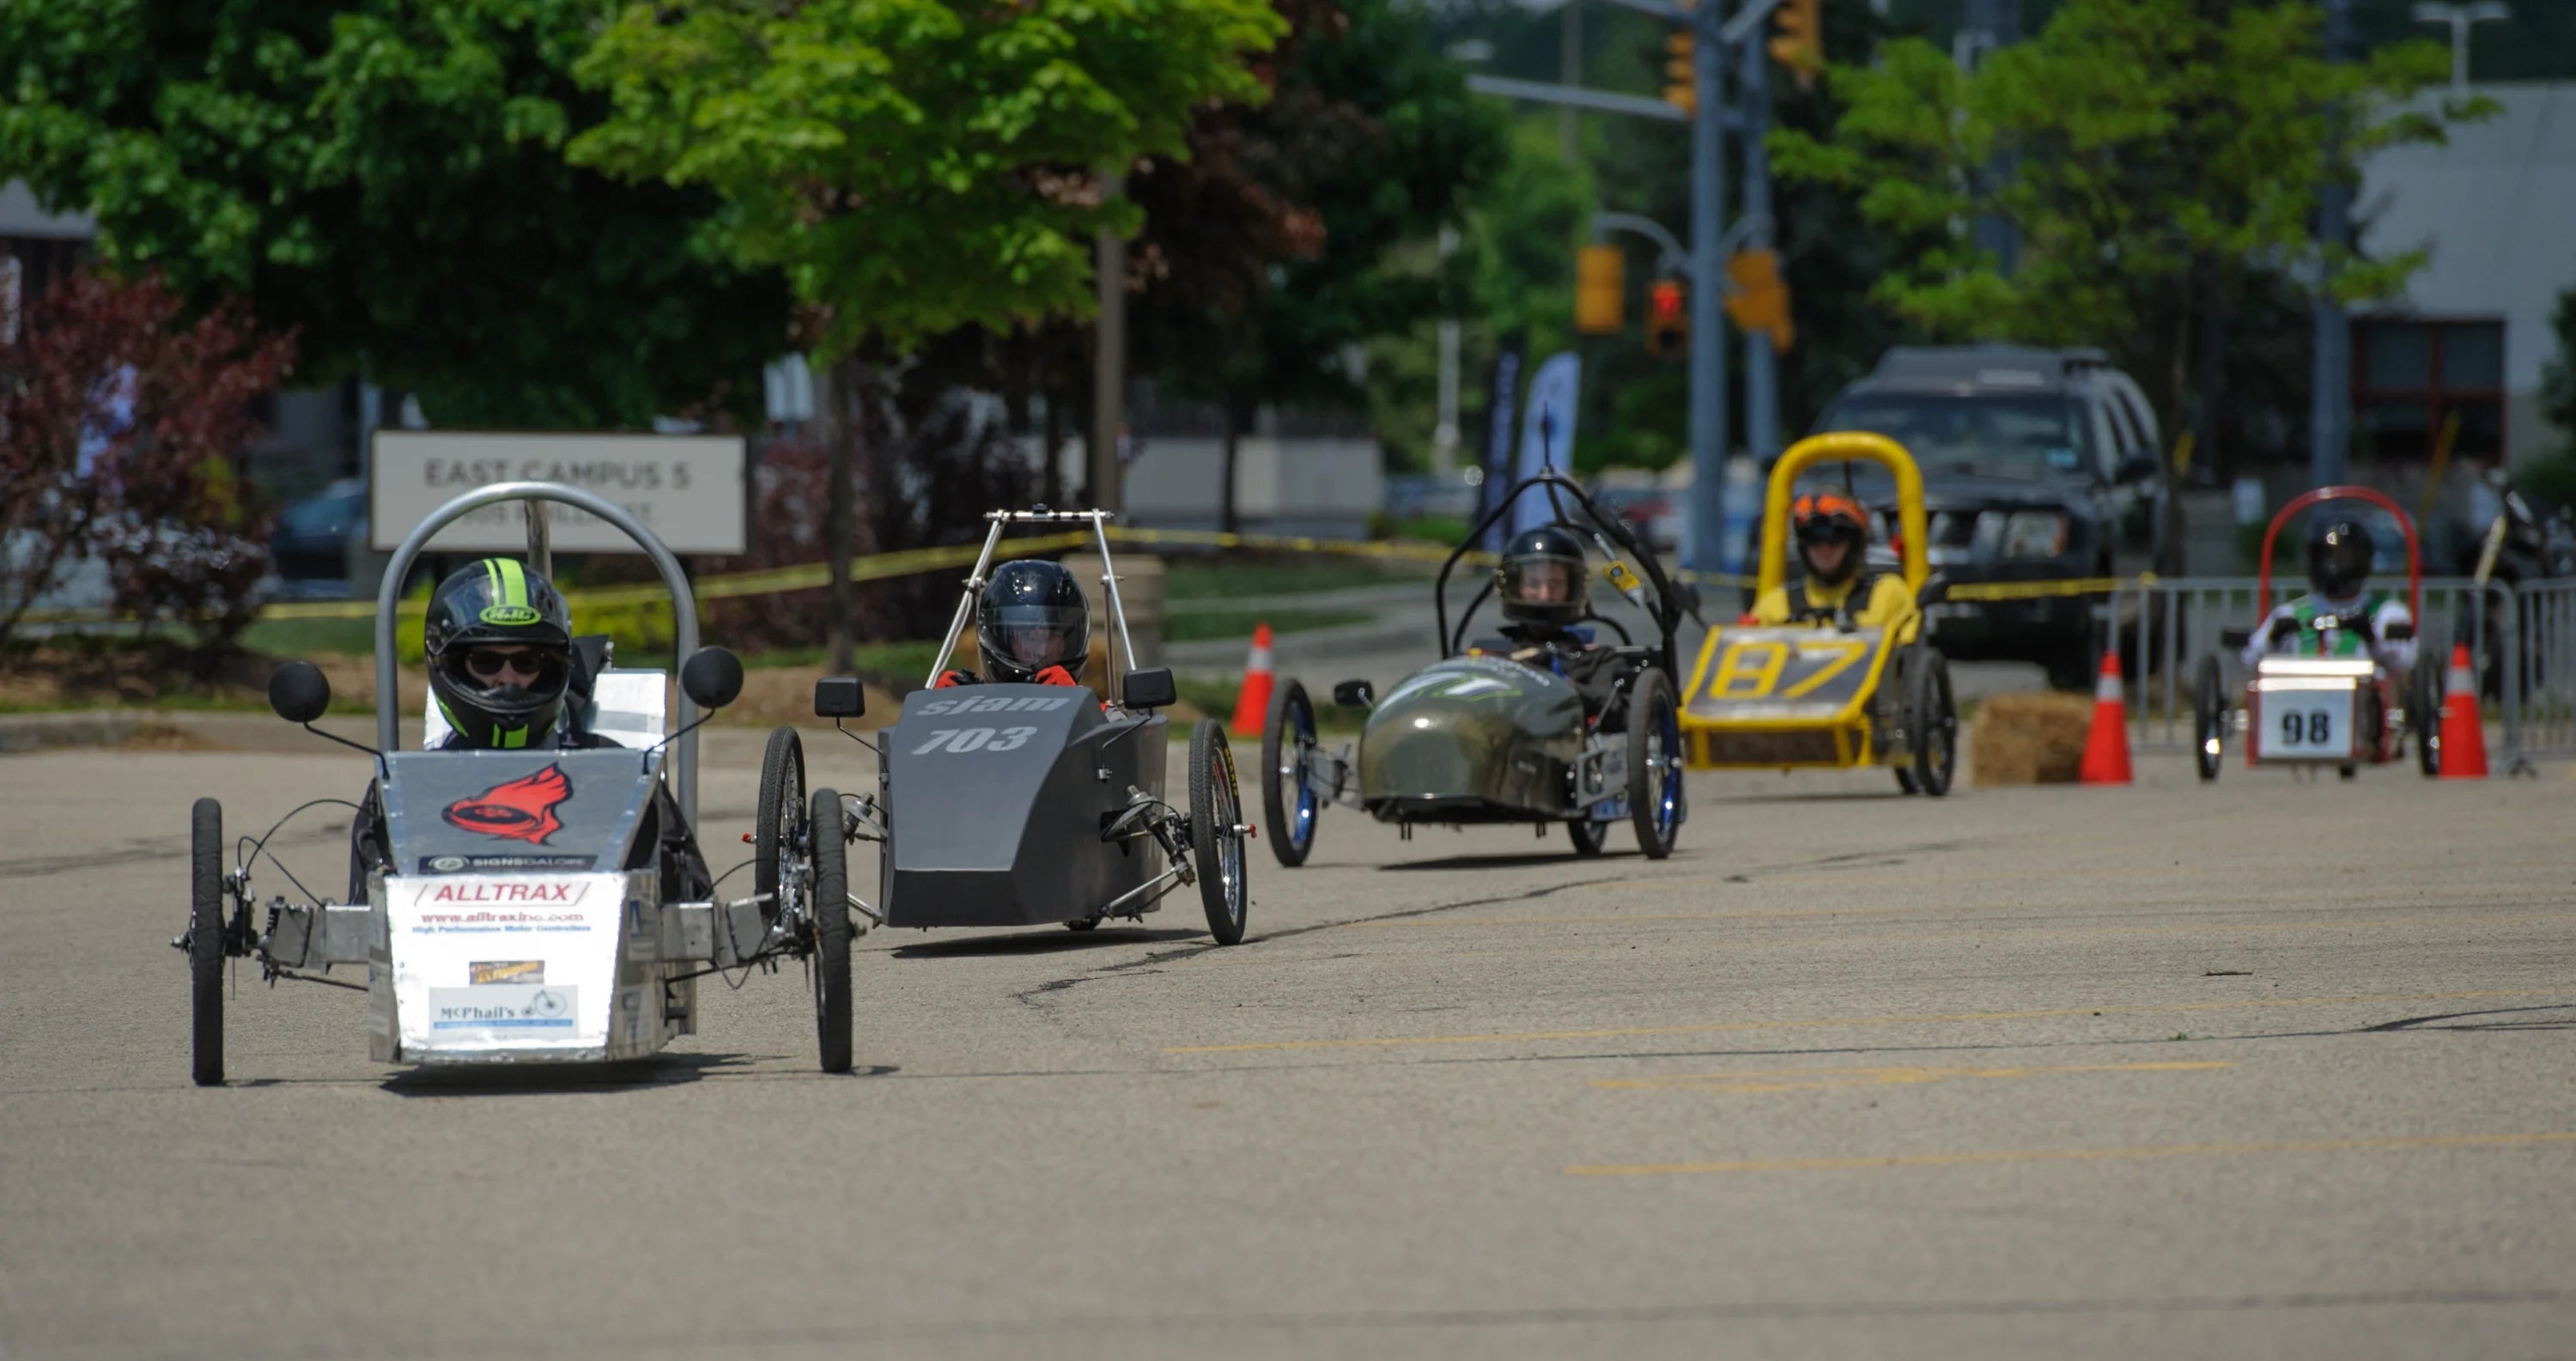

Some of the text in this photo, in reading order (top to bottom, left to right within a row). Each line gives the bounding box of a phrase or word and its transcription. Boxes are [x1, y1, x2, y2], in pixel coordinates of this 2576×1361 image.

[424, 458, 508, 487] EAST
[520, 461, 660, 489] CAMPUS
[489, 608, 532, 620] HJC
[1708, 640, 1868, 700] 87
[911, 726, 1038, 756] 703
[2281, 710, 2330, 745] 98
[434, 883, 571, 902] ALLTRAX
[421, 911, 584, 923] www.alltraxinc.com
